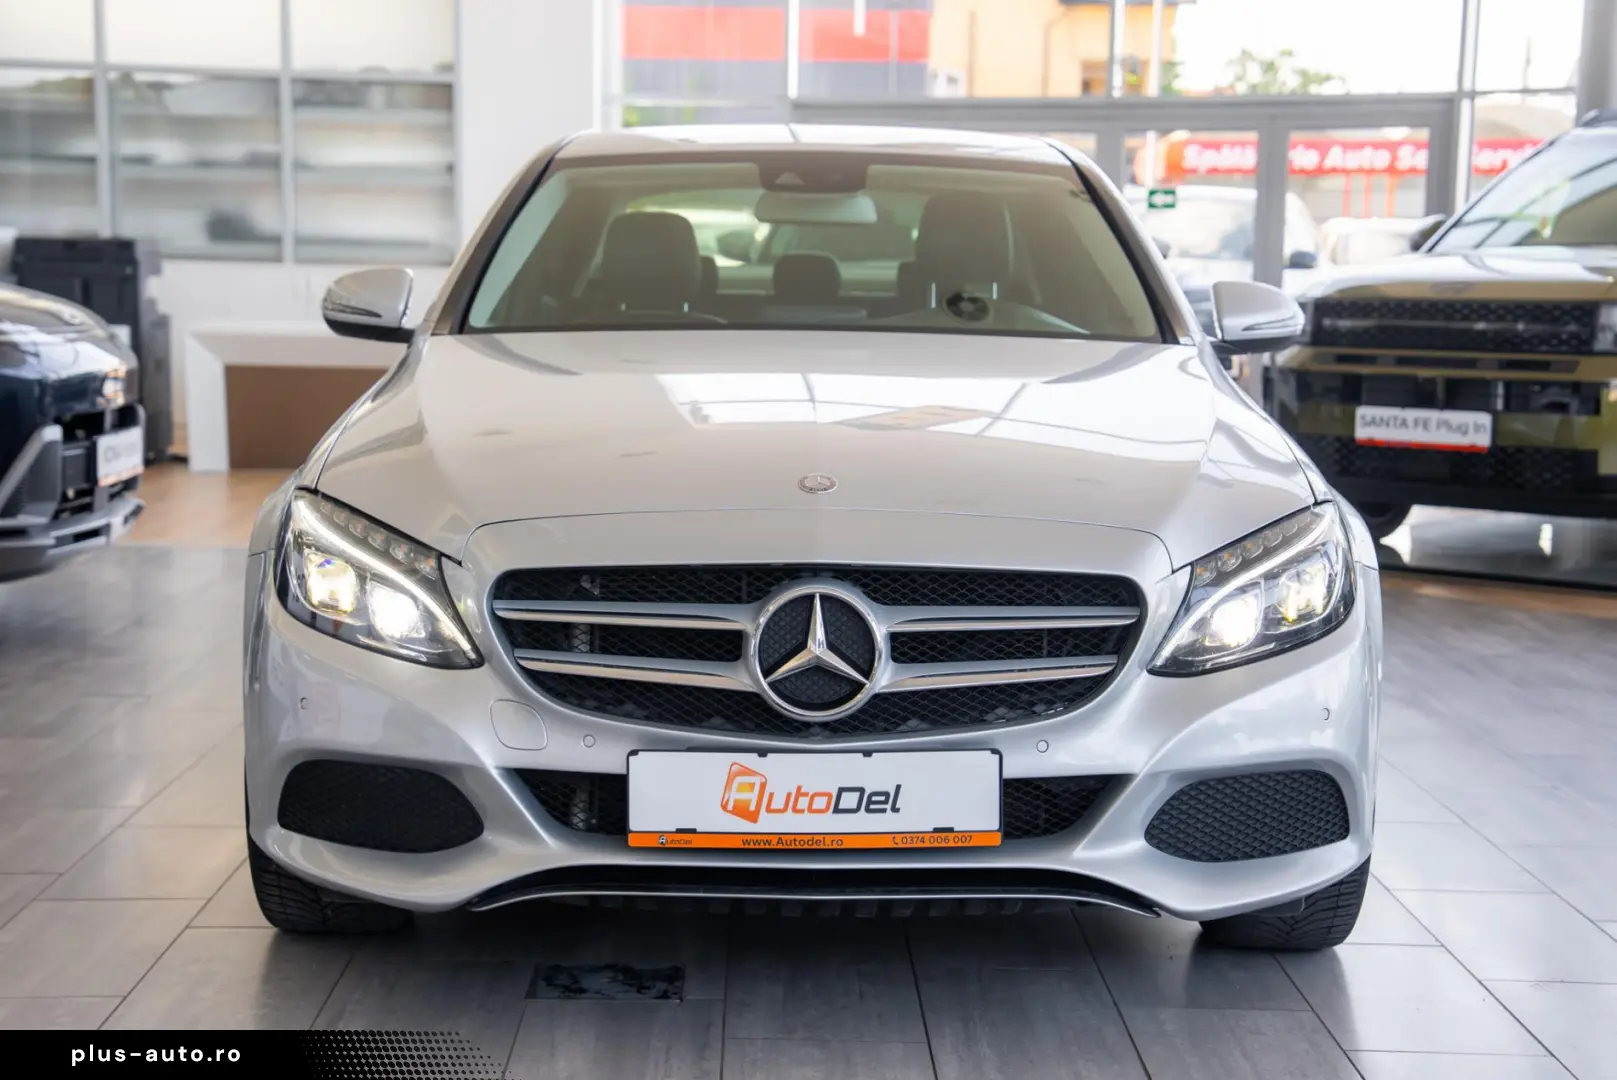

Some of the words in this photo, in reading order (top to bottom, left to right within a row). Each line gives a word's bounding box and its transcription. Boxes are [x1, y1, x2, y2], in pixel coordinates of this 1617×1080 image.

[1322, 144, 1392, 171] Auto
[1395, 144, 1429, 171] Se
[1360, 413, 1409, 431] SANTA
[1413, 416, 1432, 432] FE
[1436, 418, 1469, 437] Plug
[1473, 420, 1487, 435] In
[725, 774, 902, 815] AutoDel
[741, 836, 844, 848] www.Autodel.ro
[901, 836, 926, 845] 0374
[928, 835, 950, 845] 006
[952, 835, 972, 845] 007
